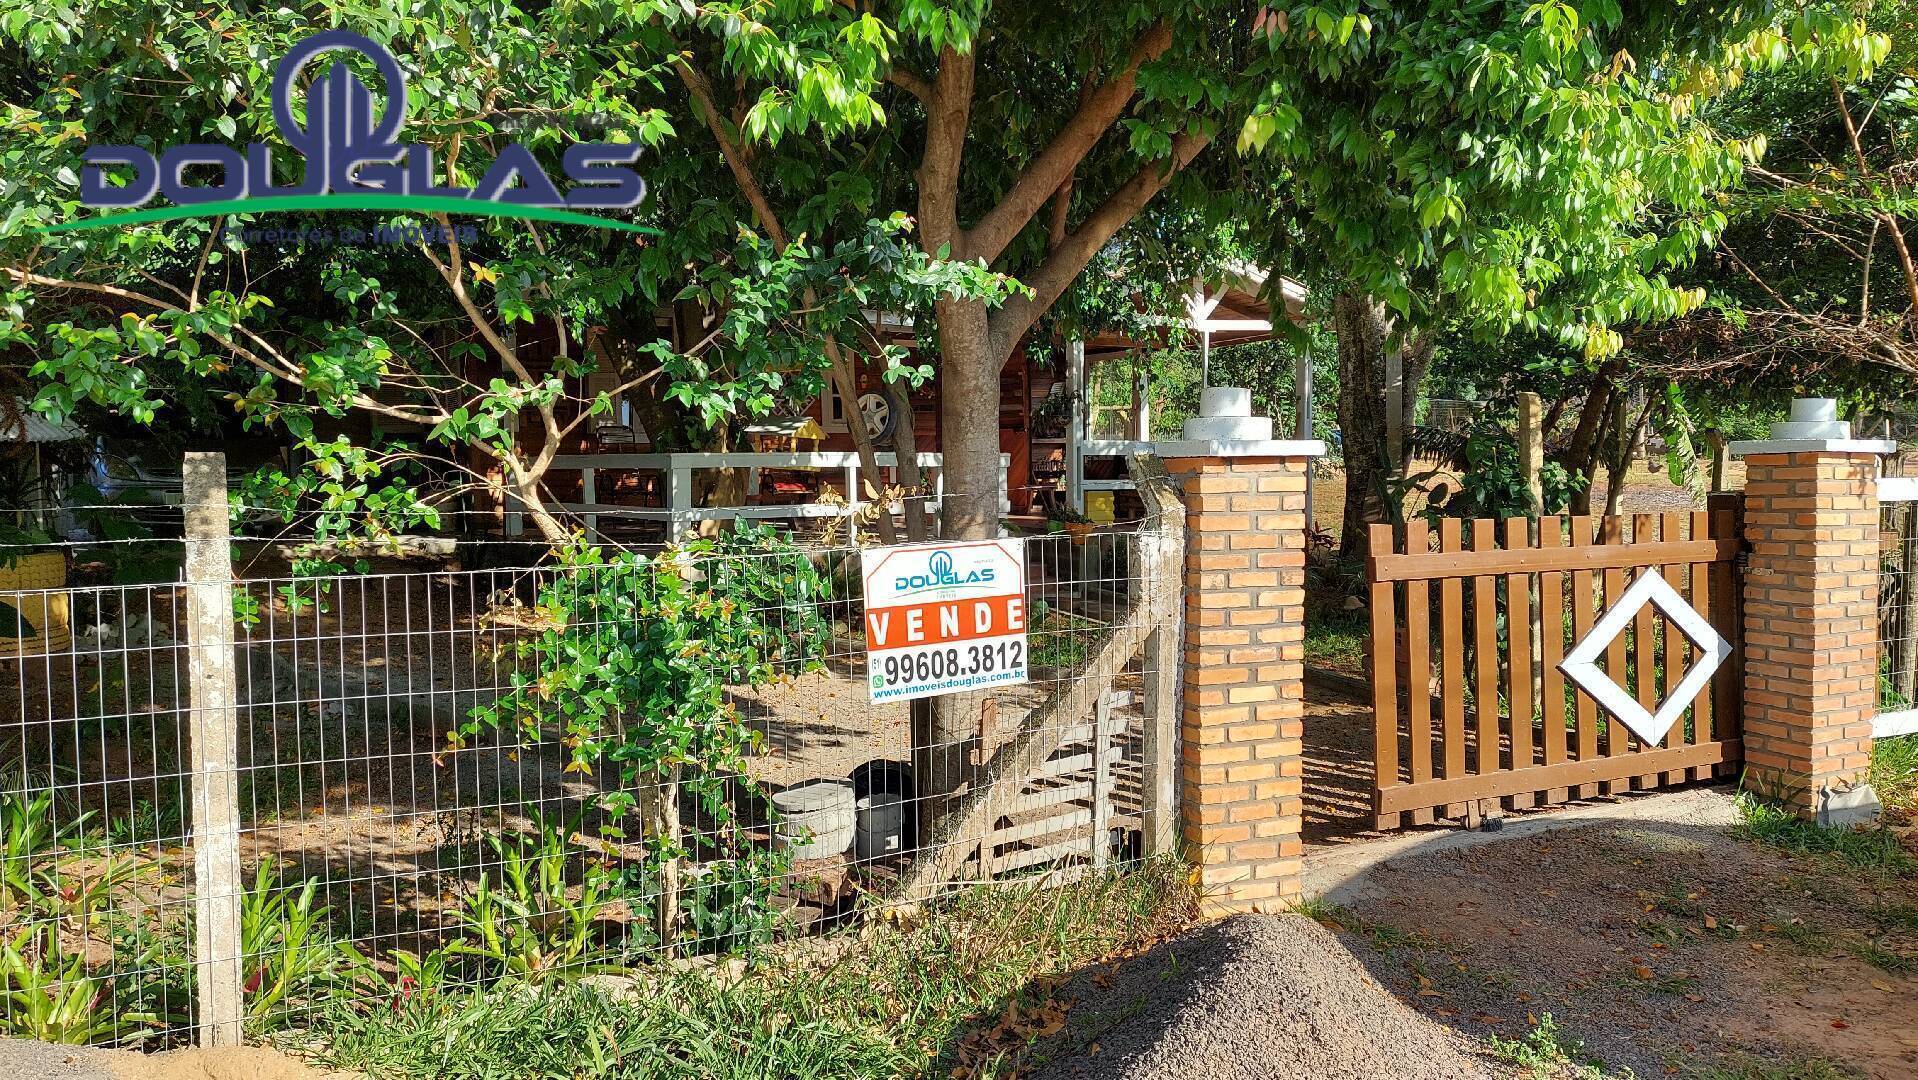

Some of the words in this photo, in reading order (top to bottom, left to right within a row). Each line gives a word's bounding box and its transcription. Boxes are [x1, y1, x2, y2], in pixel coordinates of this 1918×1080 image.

[895, 568, 995, 591] DOUGLAS
[868, 598, 1024, 646] VENDE
[885, 640, 1023, 686] 99608.3812
[873, 669, 1025, 699] www.imoveisdouglas.com.br
